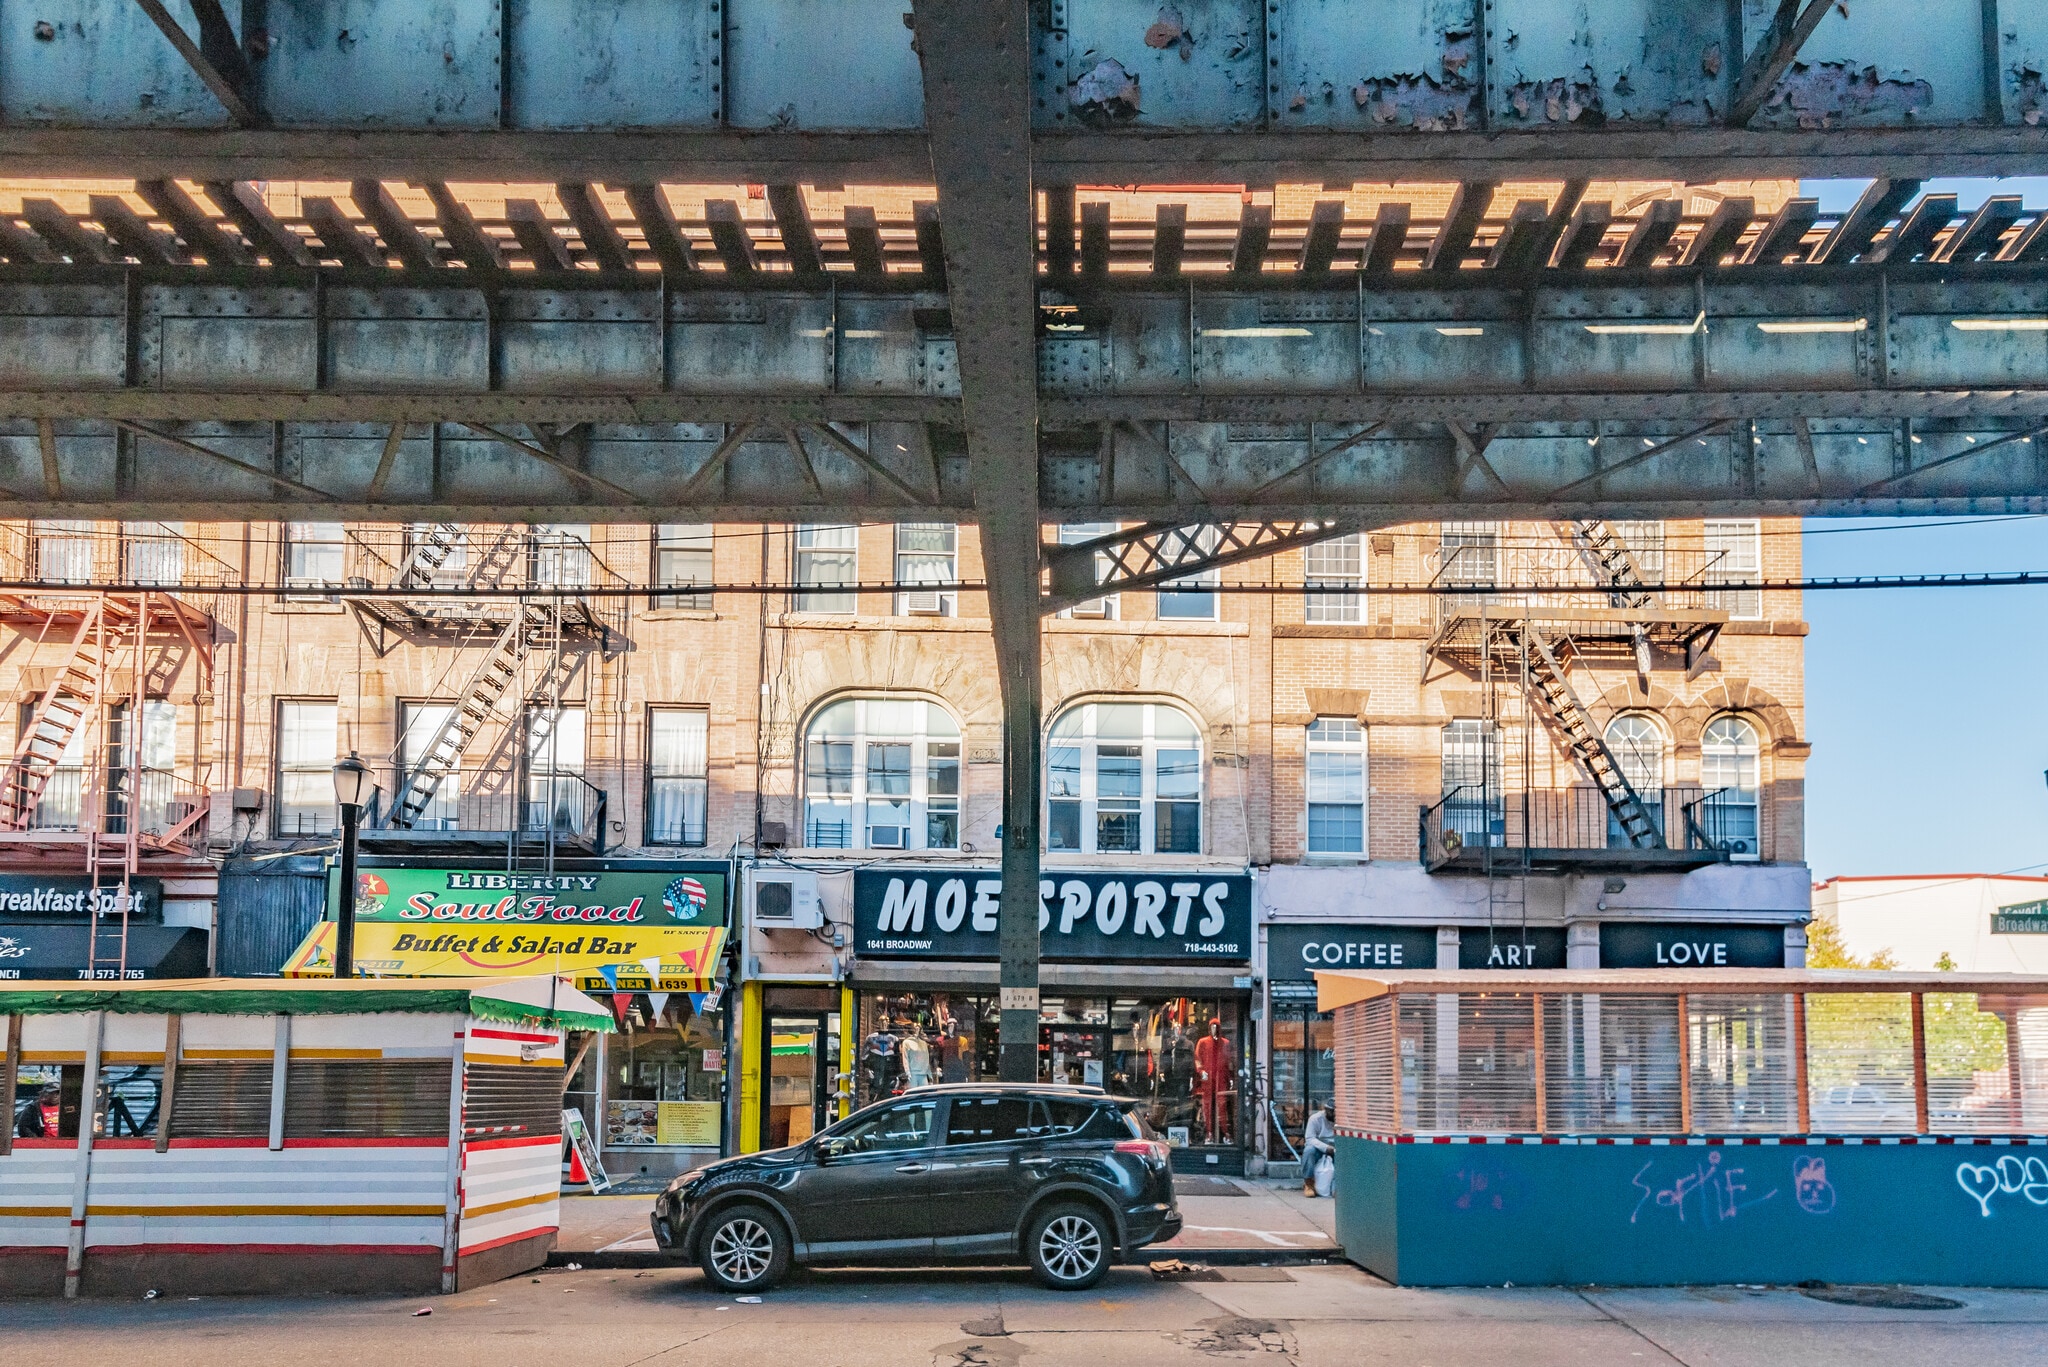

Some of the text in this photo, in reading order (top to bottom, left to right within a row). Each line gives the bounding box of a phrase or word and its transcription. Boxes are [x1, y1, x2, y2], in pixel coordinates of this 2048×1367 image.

[450, 874, 598, 890] LIBERTY
[399, 893, 645, 922] Soul Food
[877, 878, 1003, 932] MOE
[1998, 916, 2048, 932] Broadwa
[392, 934, 637, 954] Buffet & Salad Bar
[867, 940, 932, 949] 1641 BROADWAY
[1184, 943, 1238, 953] 718-443-5102
[1301, 942, 1403, 965] COFFEE
[1487, 944, 1536, 966] ART
[1656, 942, 1727, 965] LOVE
[96, 969, 145, 979] 573-765
[590, 979, 646, 989] DINER
[658, 980, 688, 990] 1639
